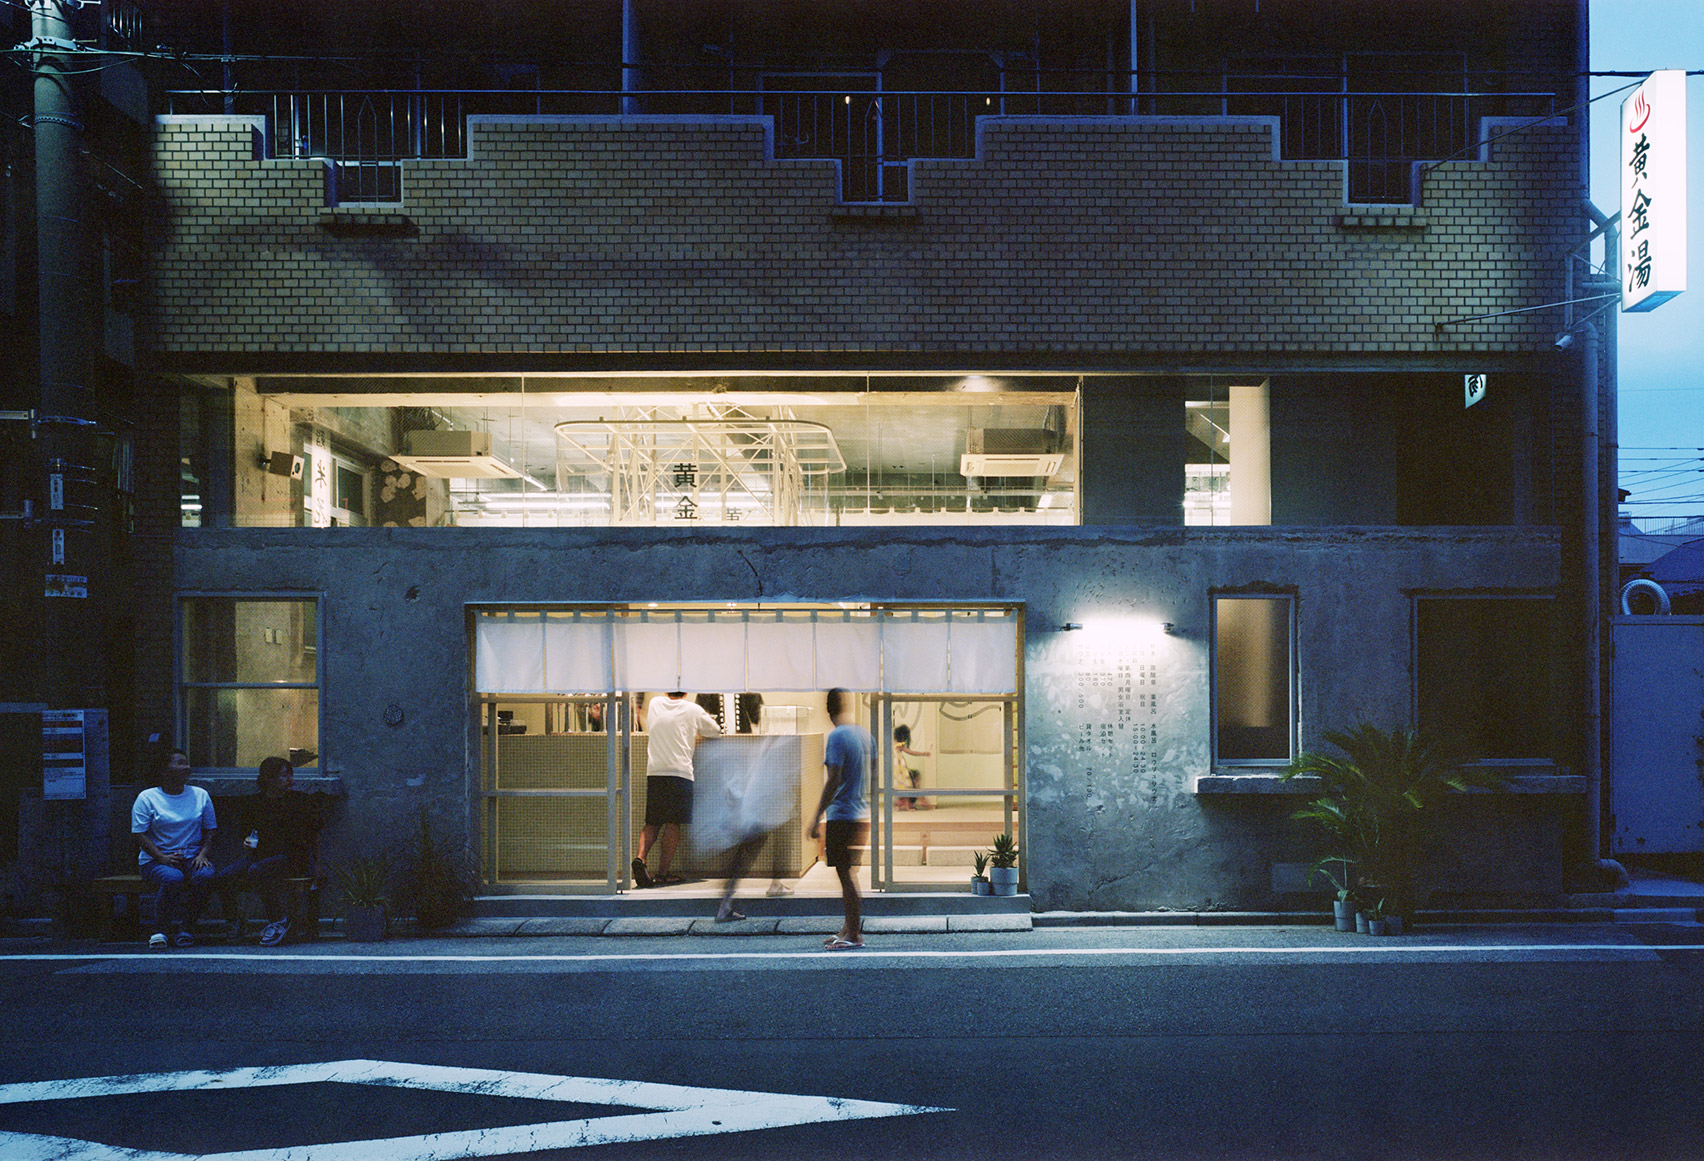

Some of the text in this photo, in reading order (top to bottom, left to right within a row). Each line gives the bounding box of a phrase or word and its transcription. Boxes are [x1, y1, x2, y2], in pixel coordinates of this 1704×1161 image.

[1628, 133, 1652, 292] 黄金湯
[673, 463, 698, 519] 黄金
[1125, 709, 1131, 722] 定休
